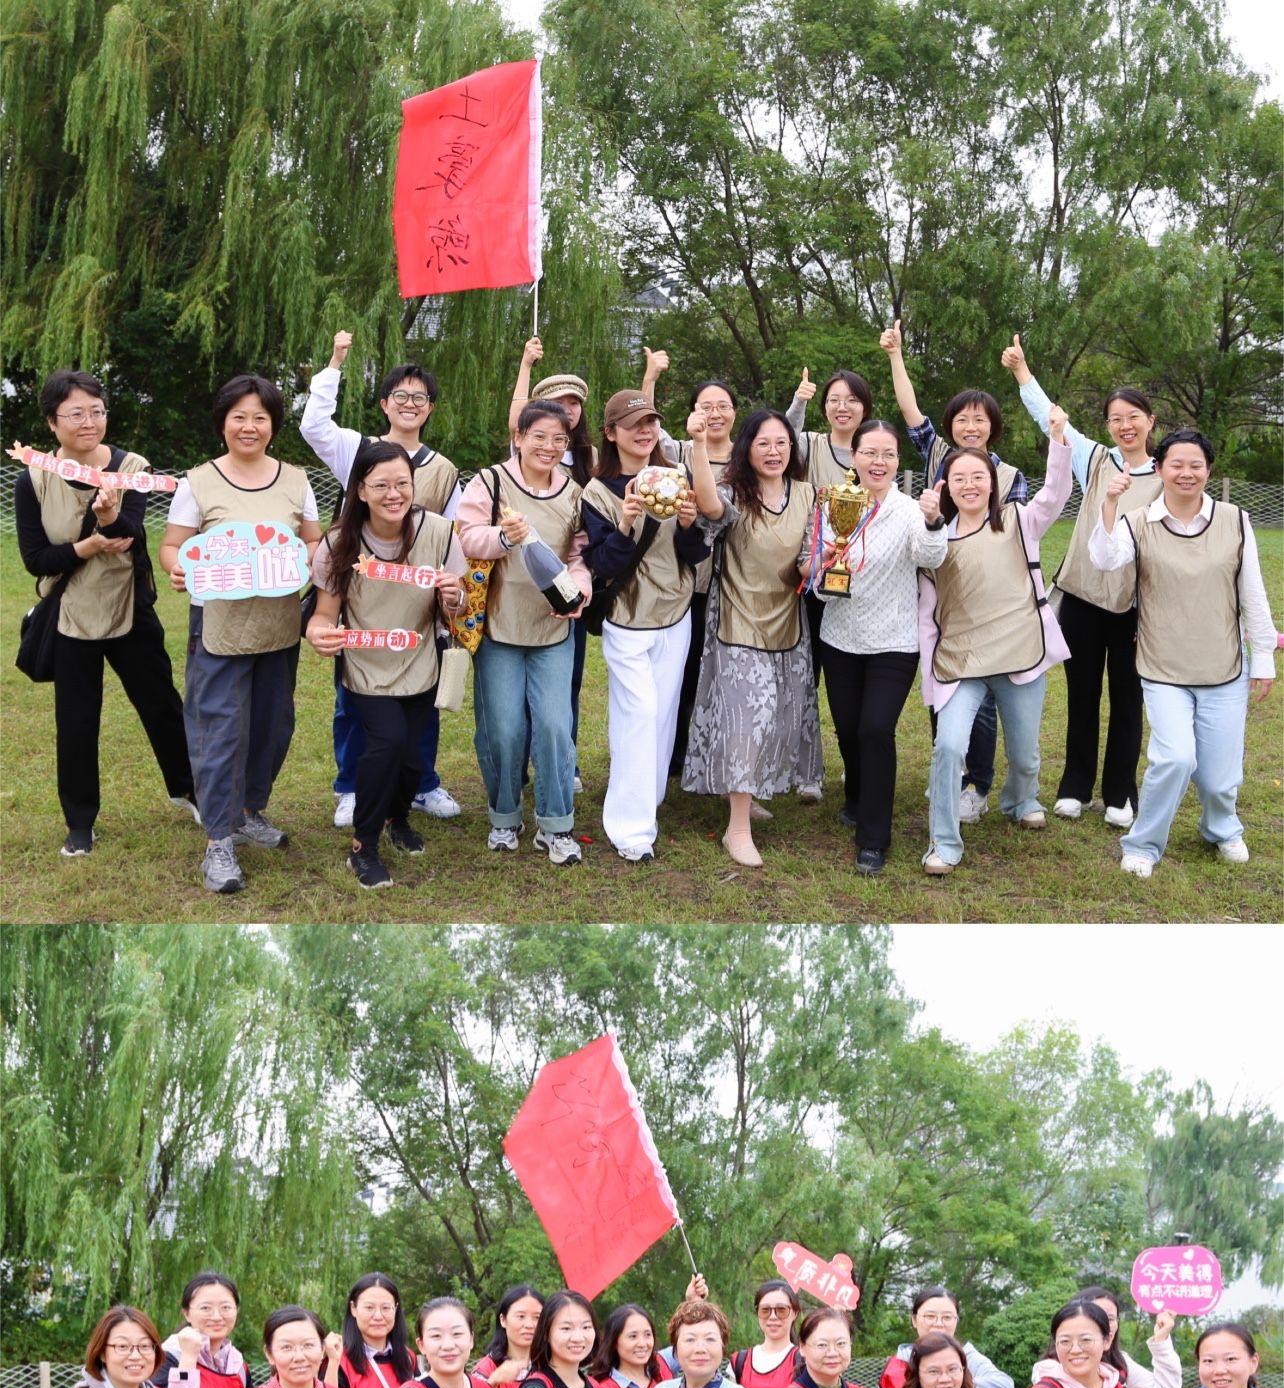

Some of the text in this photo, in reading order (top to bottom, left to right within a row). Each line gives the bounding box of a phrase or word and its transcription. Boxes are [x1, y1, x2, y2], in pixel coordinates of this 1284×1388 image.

[206, 535, 249, 560] 今天
[193, 562, 253, 594] 美美
[257, 545, 301, 590] 哒
[375, 563, 436, 586] 坐言起行
[346, 630, 406, 650] 应势而动
[777, 1247, 855, 1309] 气质非凡
[1141, 1263, 1213, 1282] 今天美得
[1138, 1284, 1213, 1299] 有点不讲道理
